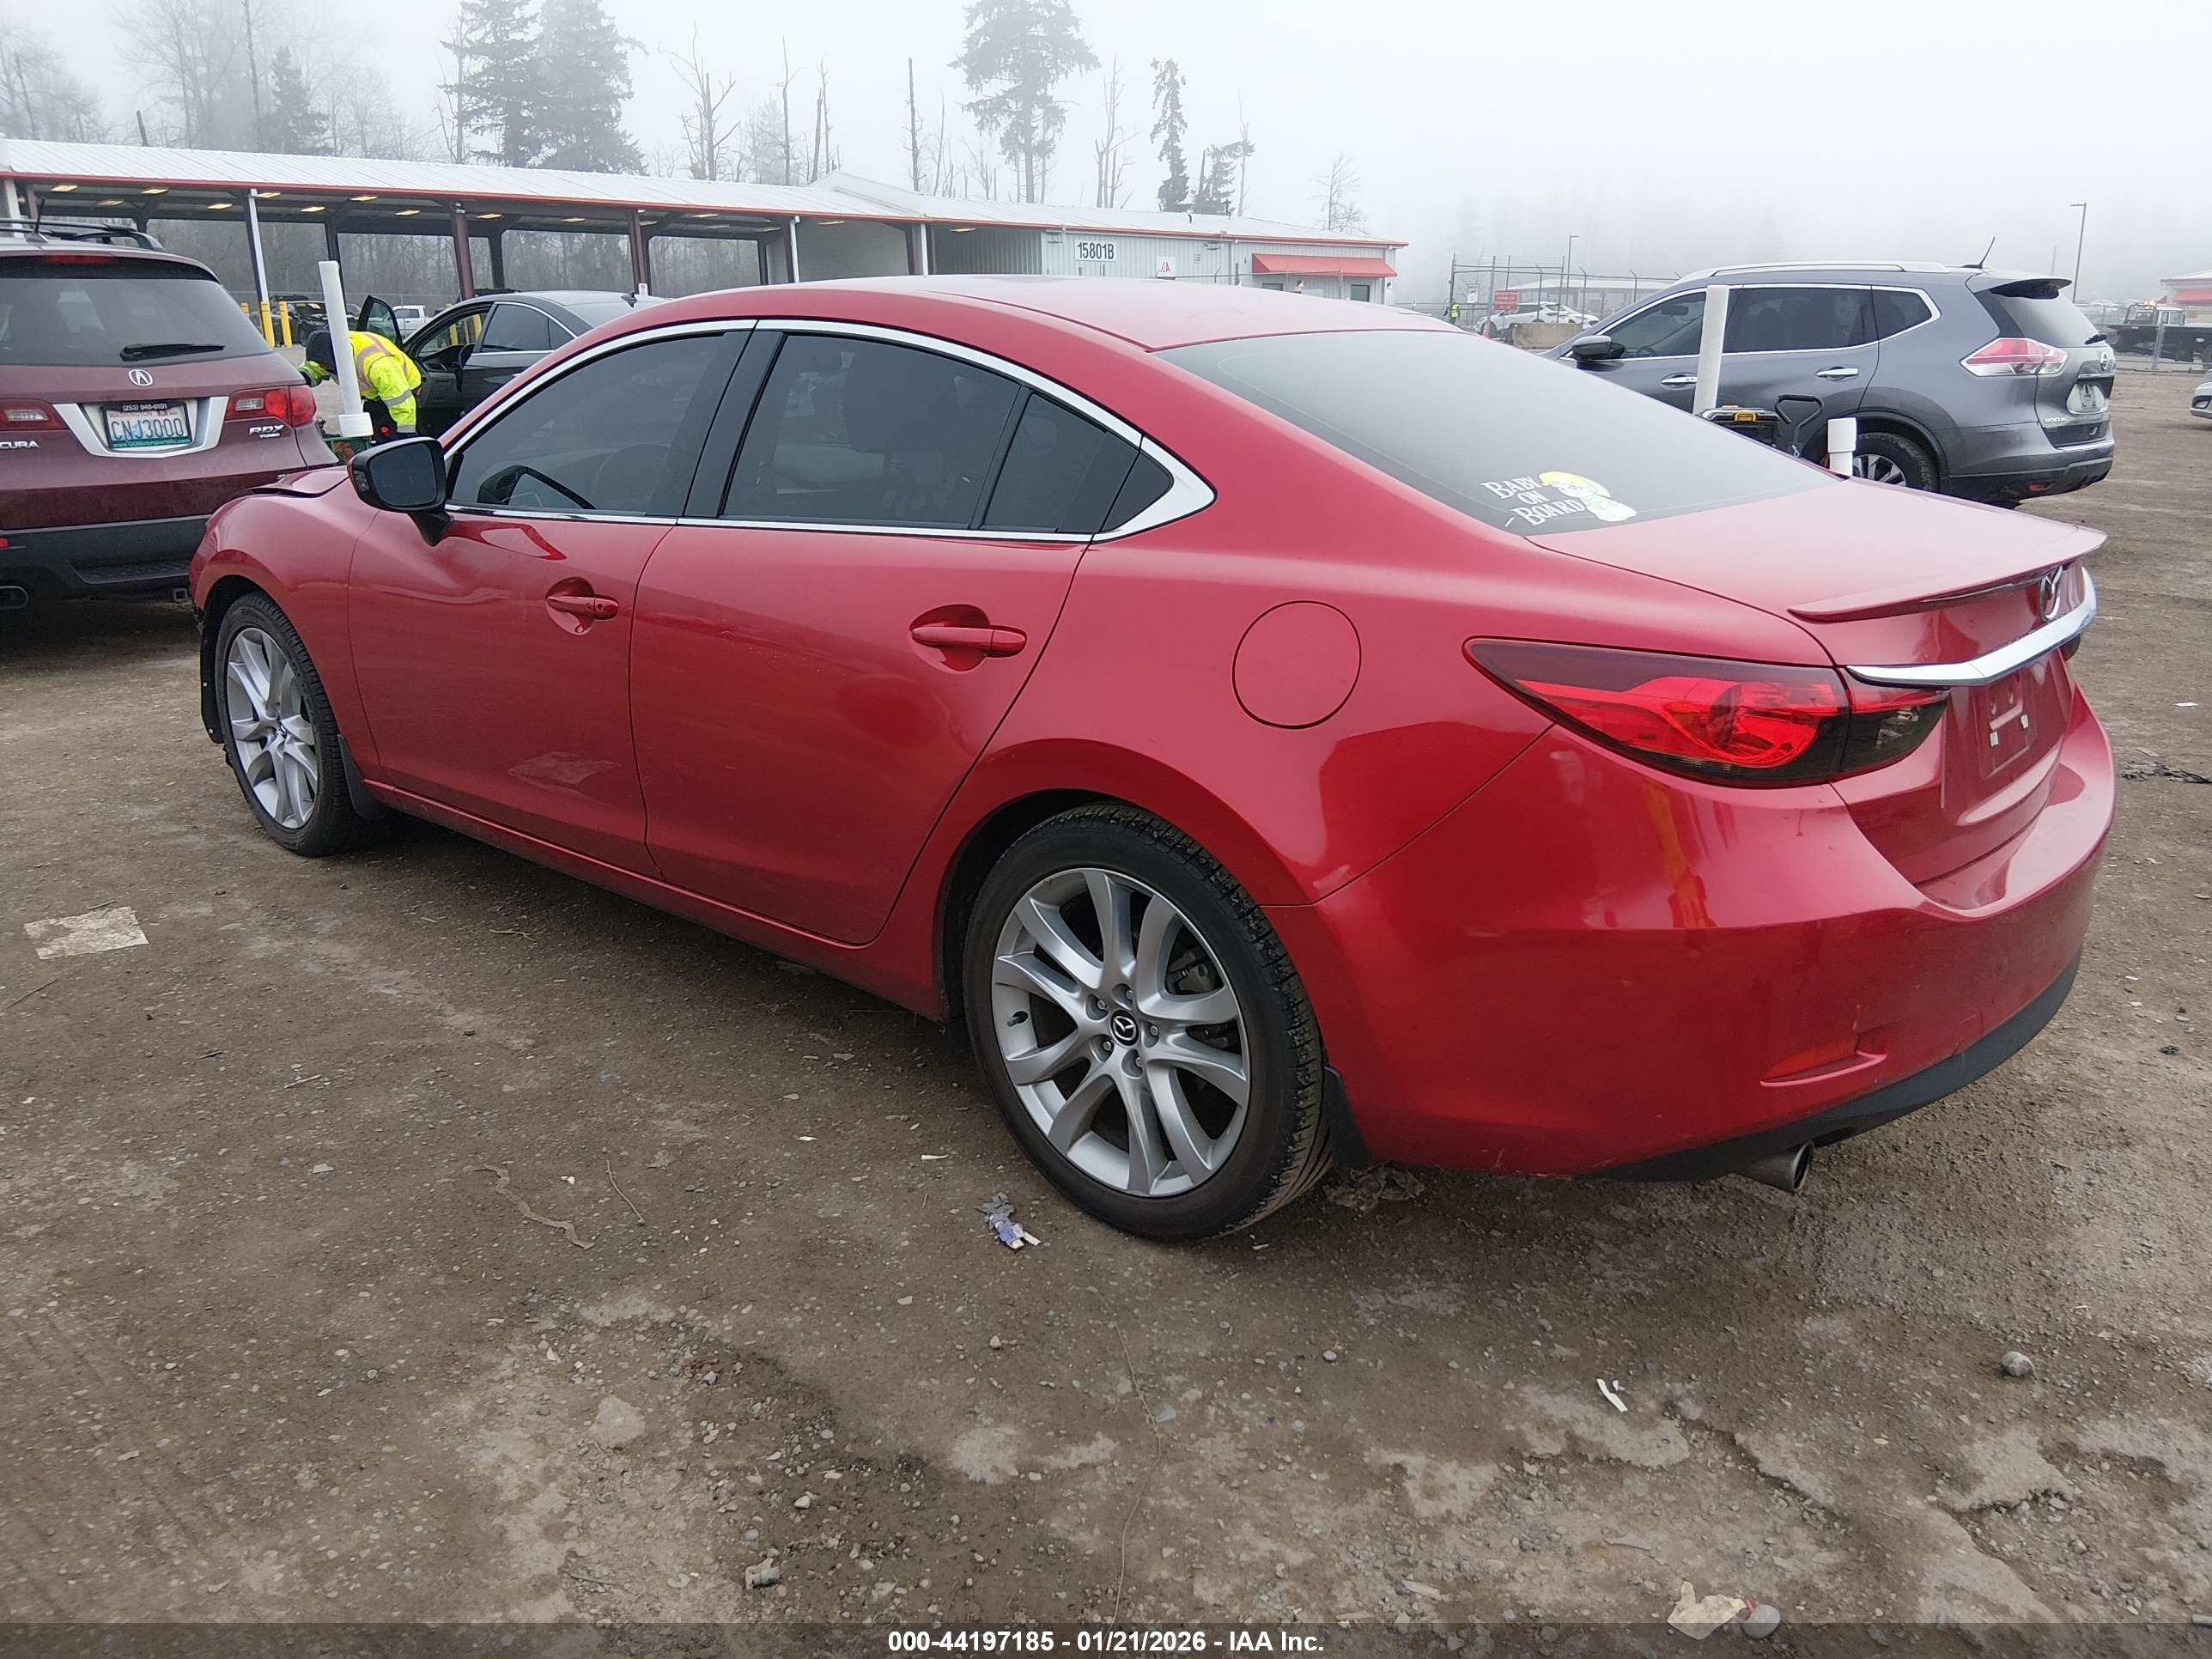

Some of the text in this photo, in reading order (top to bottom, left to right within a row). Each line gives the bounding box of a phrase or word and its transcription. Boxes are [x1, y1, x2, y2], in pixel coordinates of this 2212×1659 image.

[1077, 241, 1115, 259] 15801B
[111, 417, 184, 441] CNJ3000
[249, 424, 284, 435] RDX
[1478, 476, 1543, 500] BABY
[1516, 489, 1549, 505] ON
[1510, 499, 1587, 526] BOARD
